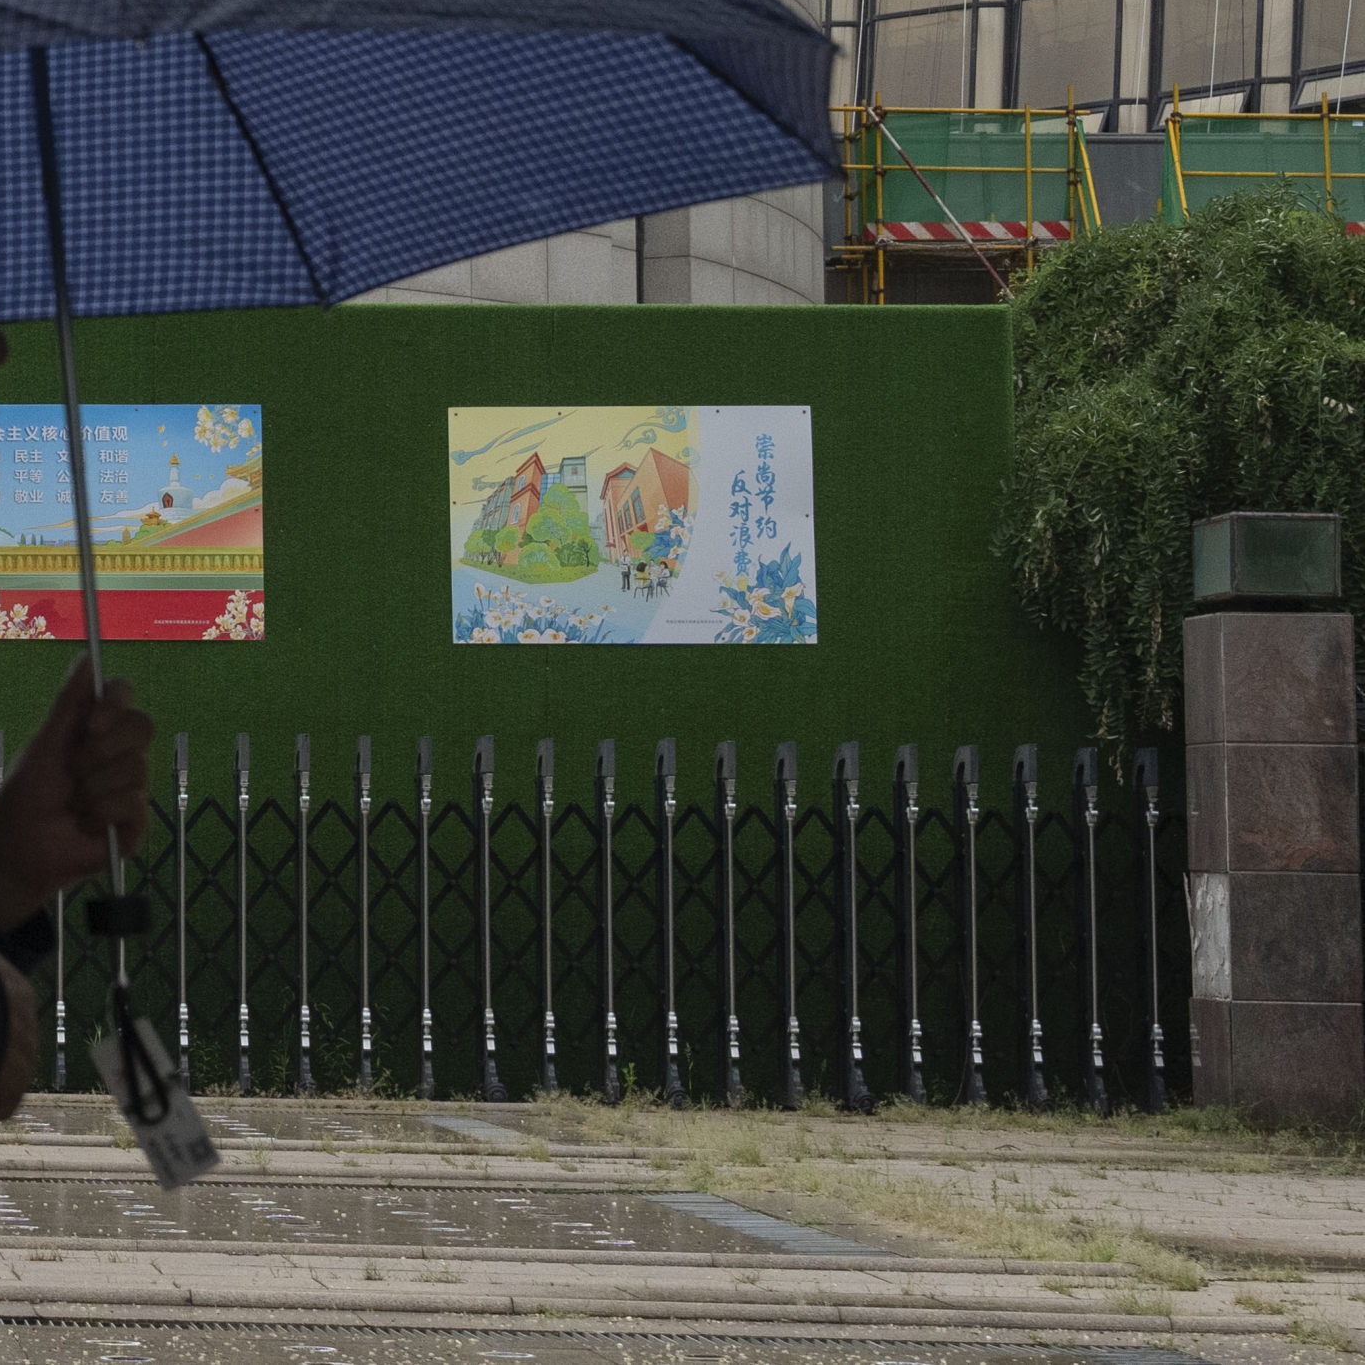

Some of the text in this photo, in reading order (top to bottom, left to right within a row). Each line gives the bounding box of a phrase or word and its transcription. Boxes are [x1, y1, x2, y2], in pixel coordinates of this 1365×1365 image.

[13, 449, 44, 463] 民主
[99, 449, 129, 463] 和谐
[13, 469, 43, 484] 平等
[99, 469, 129, 484] 法治
[754, 433, 778, 540] 崇尚节约
[14, 490, 44, 504] 敬业
[100, 490, 129, 504] 友善
[729, 469, 755, 577] 反对浪费
